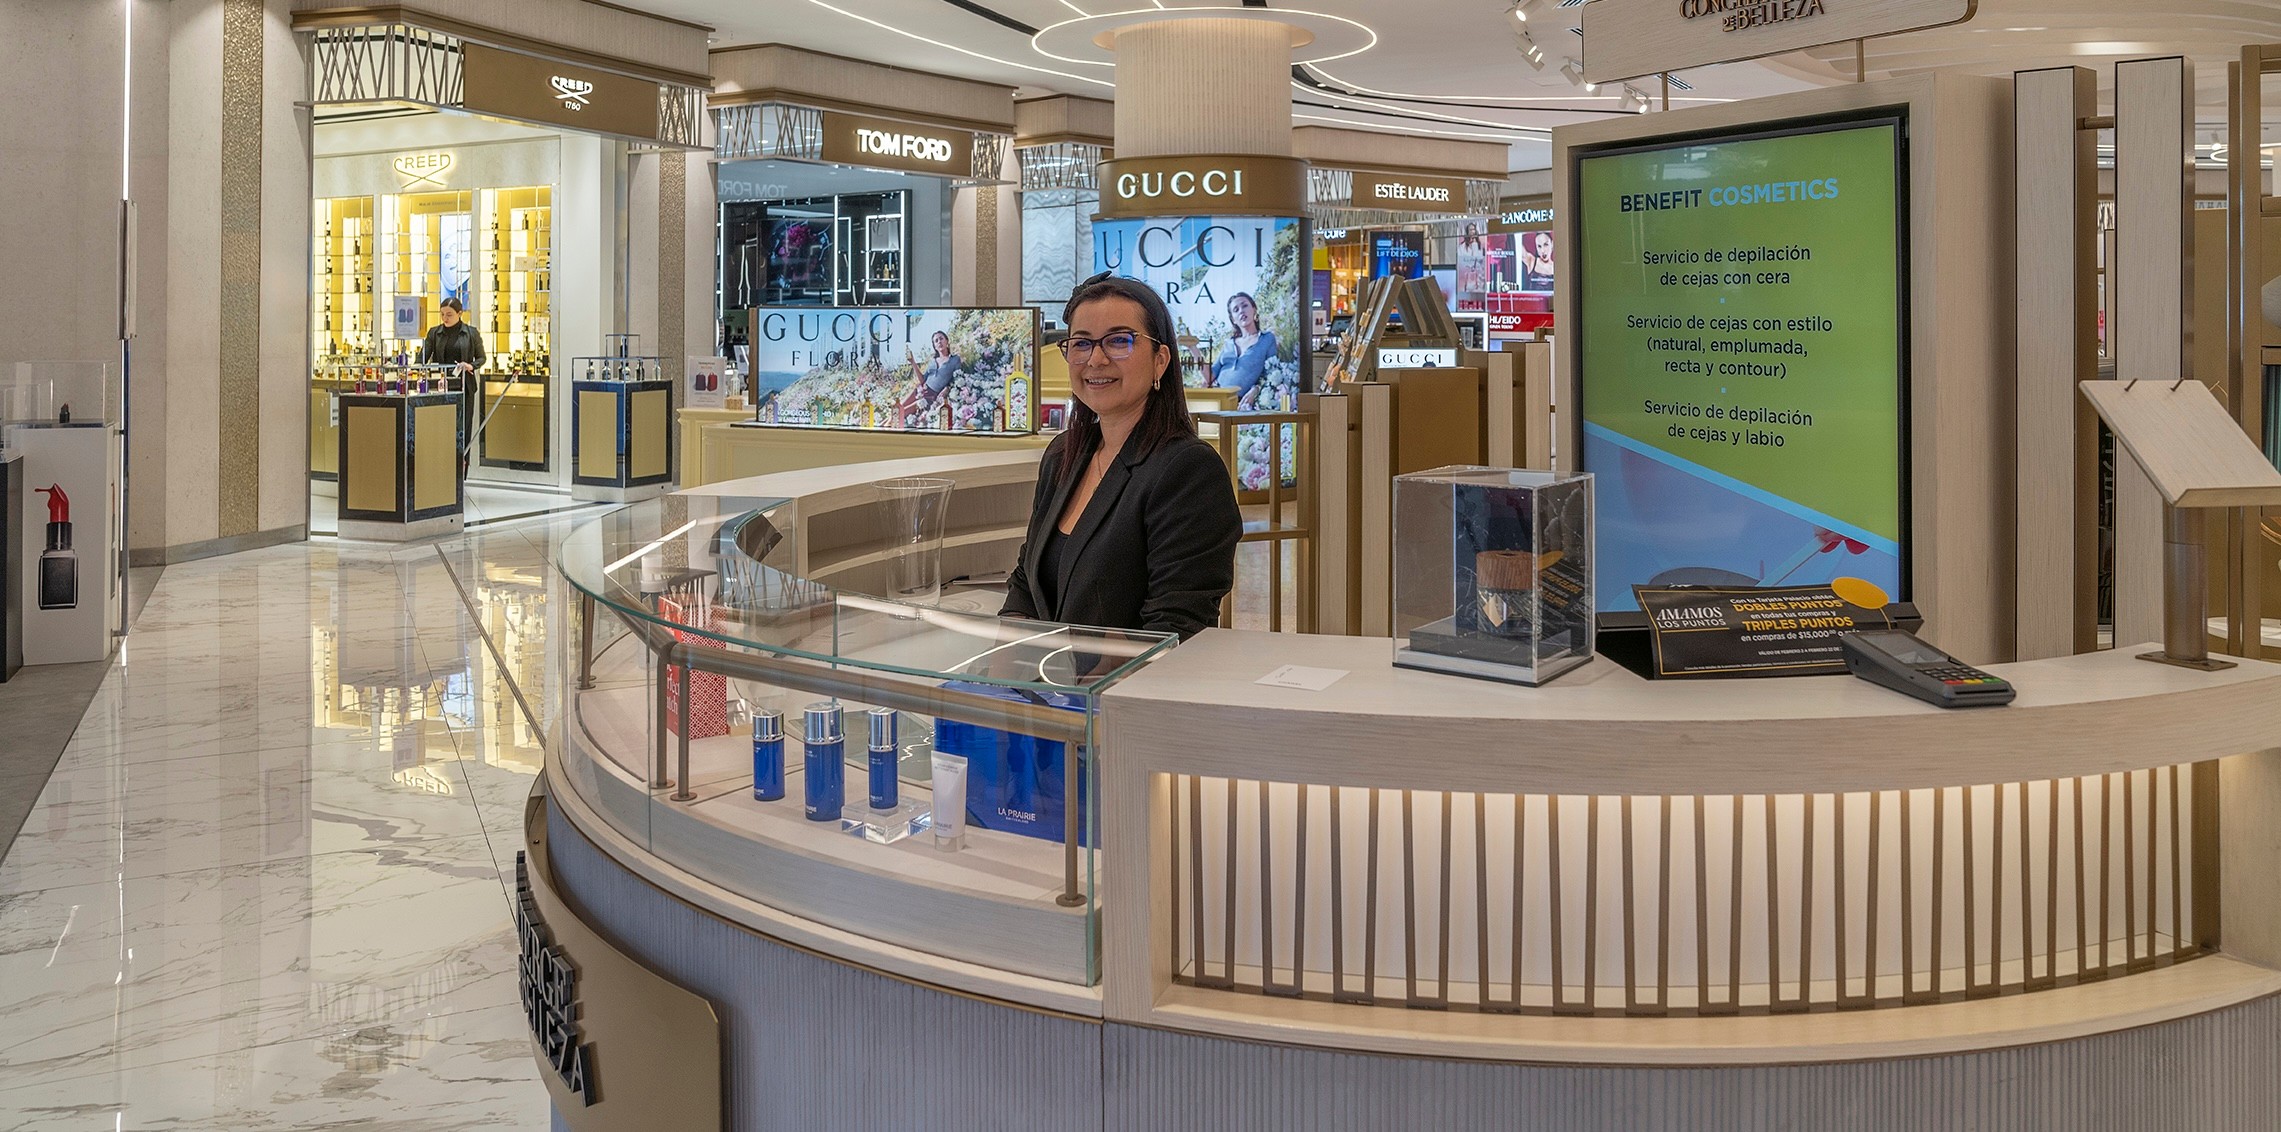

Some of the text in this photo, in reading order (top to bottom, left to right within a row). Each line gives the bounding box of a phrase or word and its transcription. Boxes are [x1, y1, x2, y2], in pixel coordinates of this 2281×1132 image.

[1737, 0, 1825, 29] BELLEZA
[551, 75, 593, 103] CREED
[565, 101, 581, 111] 1760
[857, 129, 952, 161] TOM FORD
[394, 154, 451, 183] CREED
[1117, 170, 1242, 199] GUCCI
[1408, 186, 1449, 202] LAUDER
[1620, 178, 1839, 213] BENEFIT COSMETICS
[1502, 208, 1547, 224] LANCÔME
[1093, 225, 1263, 268] UCCI
[1643, 245, 1811, 265] Servicio de depilación
[1660, 271, 1790, 288] de cejas con cera
[763, 313, 911, 343] GUCCI
[1489, 315, 1521, 325] HISEIDO
[1627, 314, 1833, 333] Servicio de cejas con estilo
[1647, 336, 1808, 357] (natural, emplumada,
[792, 350, 883, 368] FLORA
[1382, 353, 1442, 364] GUCCI
[1664, 360, 1787, 379] recta y contour)
[1644, 400, 1812, 427] Servicio de depilación
[1668, 423, 1785, 447] de cejas y labio
[1733, 599, 1843, 612] DOBLES PUNTOS
[1757, 596, 1782, 604] Tarjeta
[1656, 606, 1723, 620] AMAMOS
[1761, 611, 1784, 619] todas
[1798, 610, 1830, 619] compras
[1657, 618, 1727, 628] LOS PUNTOS
[1742, 616, 1854, 631] TRIPLES PUNTOS
[1752, 633, 1786, 642] compras
[1787, 631, 1797, 640] de
[997, 807, 1036, 822] LA PRAIRIE
